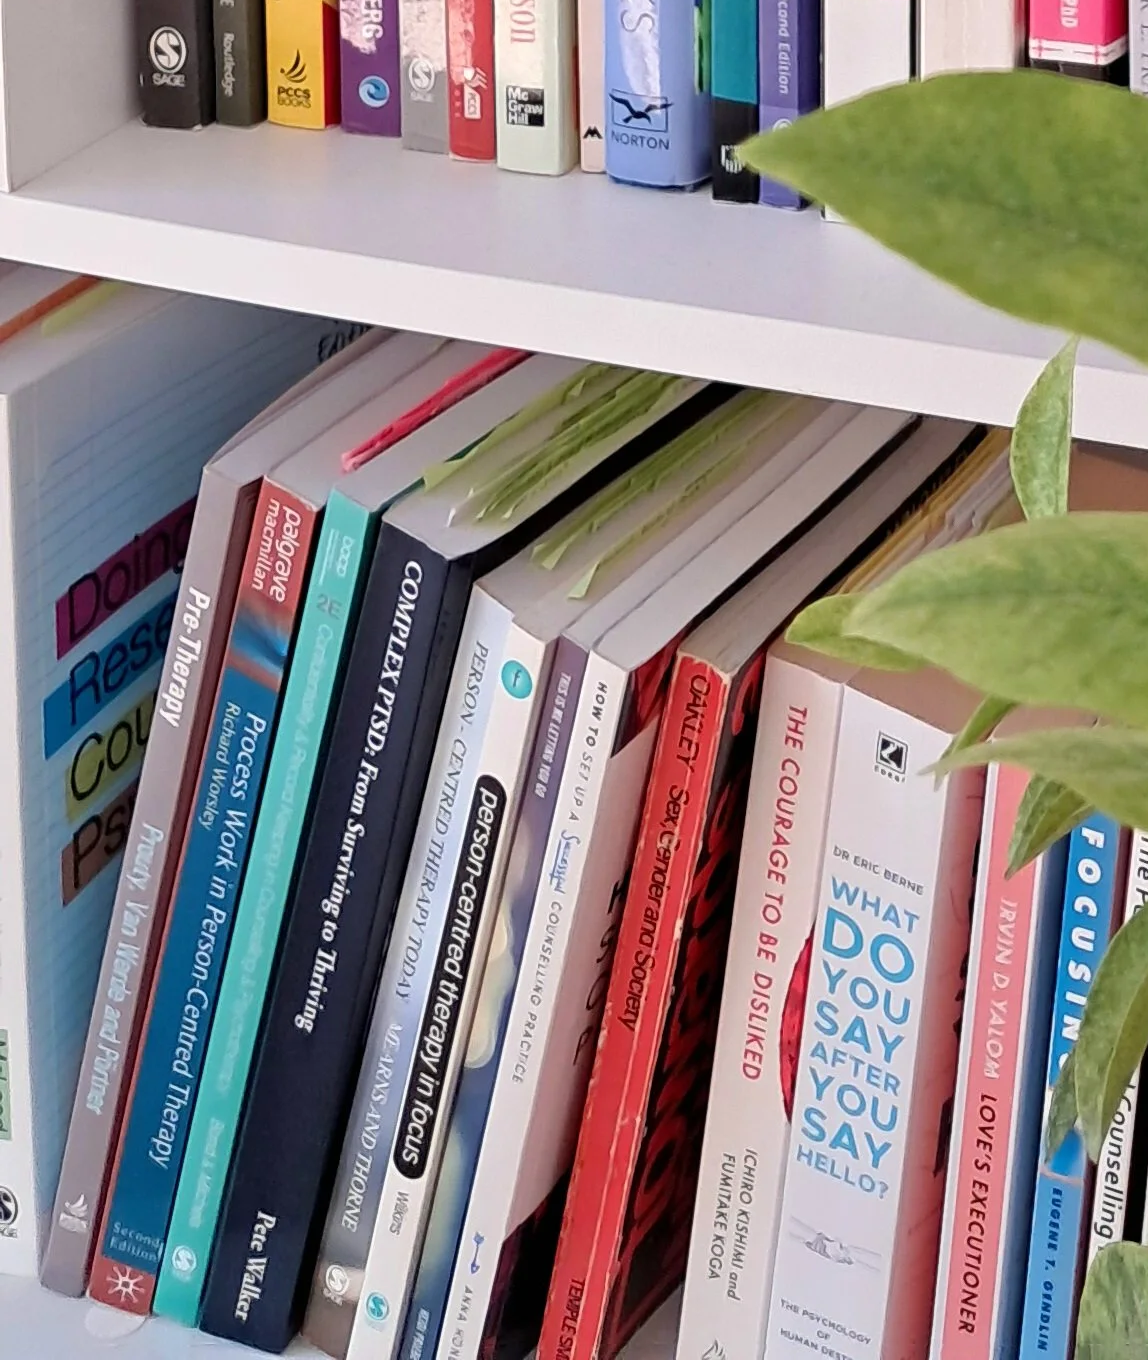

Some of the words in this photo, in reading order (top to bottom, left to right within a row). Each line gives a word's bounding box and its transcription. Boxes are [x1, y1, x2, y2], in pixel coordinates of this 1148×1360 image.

[250, 497, 282, 592] macmillan
[268, 504, 301, 604] palgrave
[380, 559, 424, 687] COMPLEX
[158, 585, 212, 729] Pre-Therapy
[212, 700, 244, 764] Richard
[363, 683, 397, 758] PTSD:
[784, 704, 808, 752] THE
[228, 711, 268, 802] Process
[349, 758, 380, 816] From
[195, 767, 227, 831] Worsley
[766, 757, 802, 886] COURAGE
[215, 807, 249, 872] Work
[320, 817, 366, 919] Surviving
[832, 844, 851, 862] DR
[852, 854, 881, 876] ERIC
[883, 867, 925, 897] BERNE
[208, 875, 234, 900] in
[442, 785, 499, 980] person-centred
[761, 891, 785, 926] TO
[830, 875, 921, 934] WHAT
[321, 919, 341, 943] to
[755, 931, 780, 965] BE
[821, 906, 915, 985] DO
[171, 903, 228, 1080] Person-Centred
[293, 947, 339, 1034] Thriving
[822, 959, 911, 1026] YOU
[419, 981, 460, 1074] therapy
[741, 970, 774, 1082] DISLIKED
[813, 999, 906, 1064] SAY
[416, 1071, 441, 1098] in
[808, 1065, 899, 1133] YOU
[809, 1040, 902, 1098] AFTER
[148, 1083, 192, 1171] Therapy
[401, 1101, 435, 1167] focus
[800, 1106, 893, 1170] SAY
[974, 1092, 999, 1175] LOVE'S
[795, 1143, 890, 1200] HELLO?
[250, 1210, 278, 1253] Pete
[957, 1179, 990, 1335] EXECUTIONER
[234, 1257, 268, 1325] Walker
